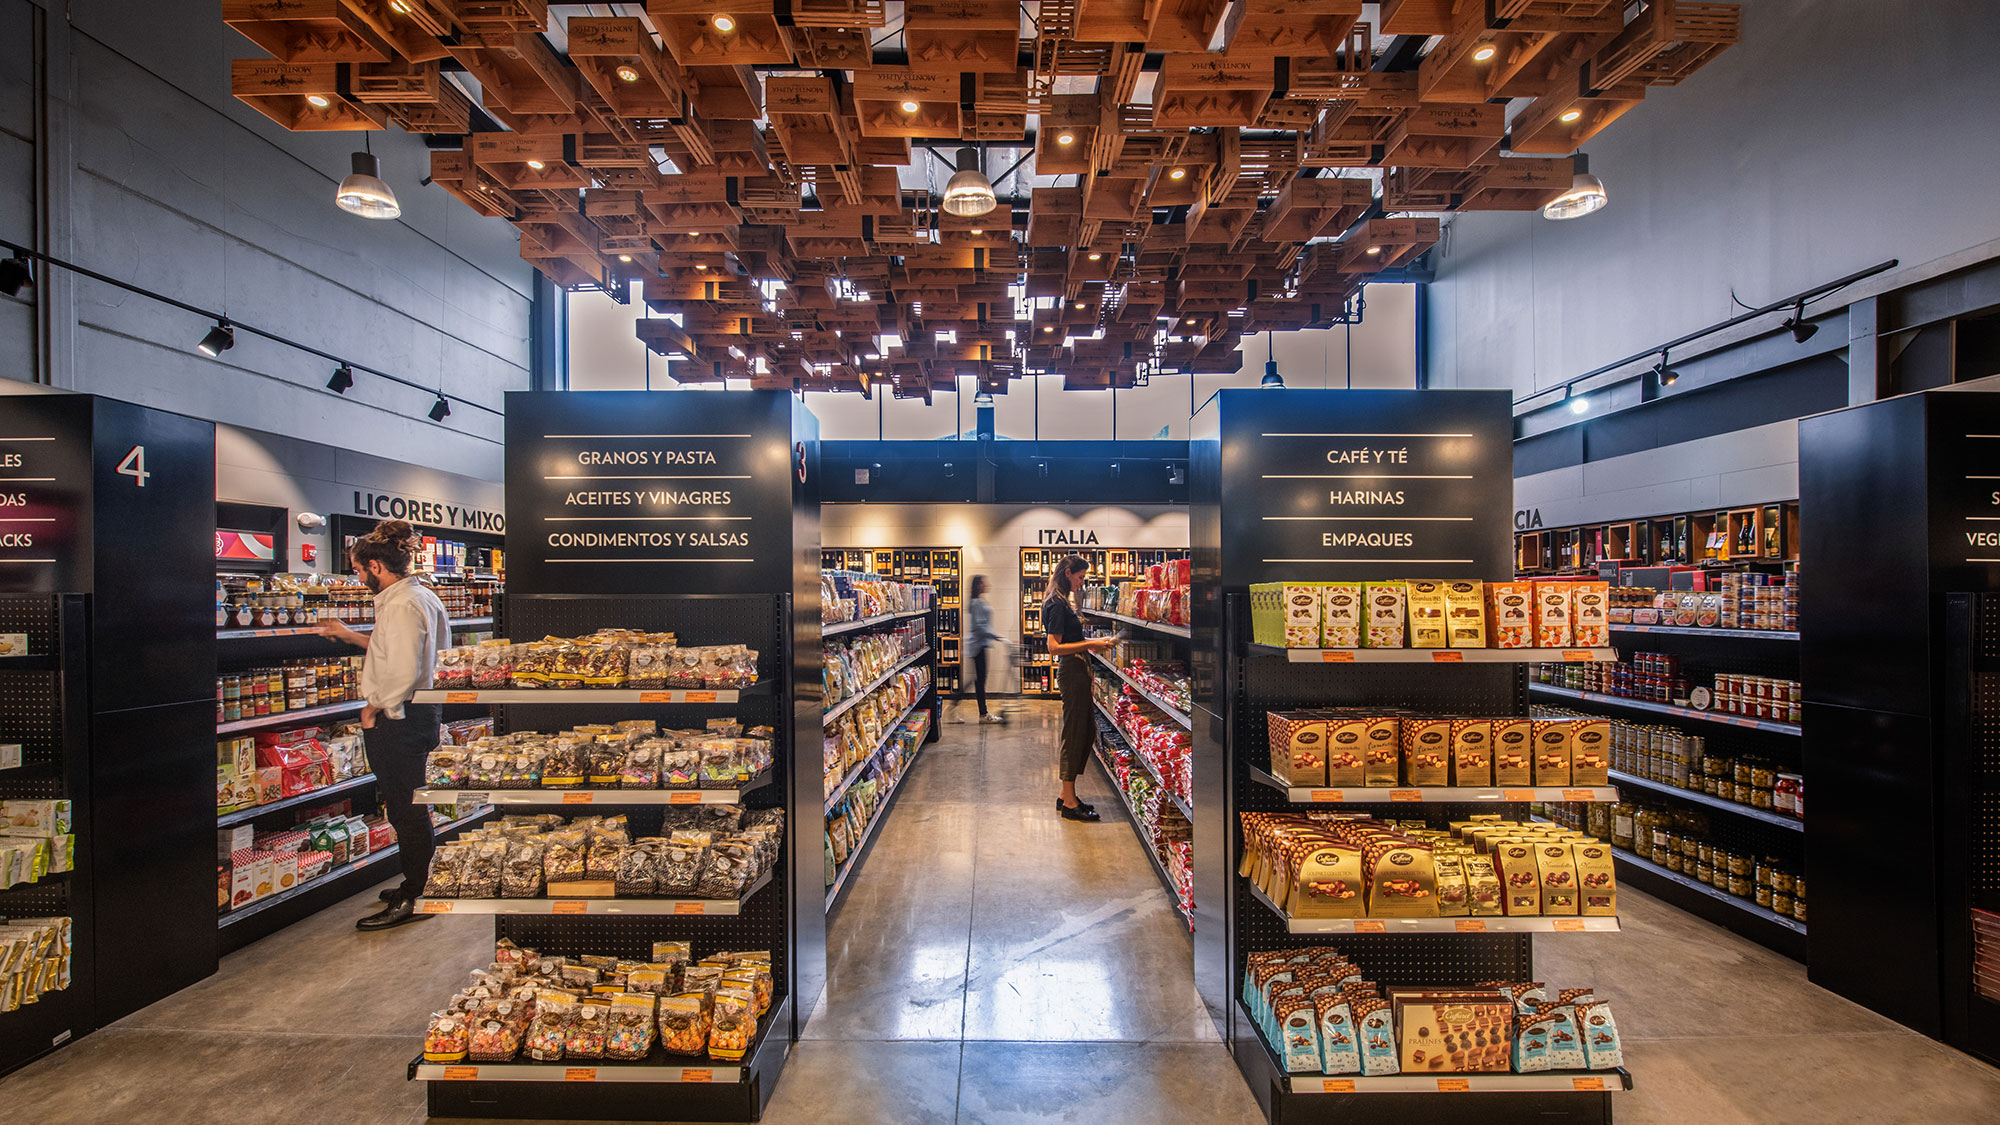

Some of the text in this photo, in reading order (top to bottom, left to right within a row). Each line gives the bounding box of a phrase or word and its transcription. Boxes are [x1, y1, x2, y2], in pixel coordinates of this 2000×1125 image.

[255, 66, 312, 75] MONTES ALPHA
[877, 73, 903, 81] ALPHA
[578, 451, 717, 465] GRANOS Y PASTA
[796, 441, 807, 484] 3
[1327, 447, 1408, 464] CAFÉ Y TÉ
[116, 445, 151, 487] 4
[565, 491, 731, 505] ACEITES Y VINAGRES
[1330, 491, 1405, 505] HARINAS
[354, 491, 505, 532] LICORES Y MIXO
[1514, 508, 1543, 530] CIA
[548, 533, 749, 547] CONDIMENTOS Y SALSAS
[1039, 530, 1099, 545] ITALIA
[1322, 533, 1413, 549] EMPAQUES
